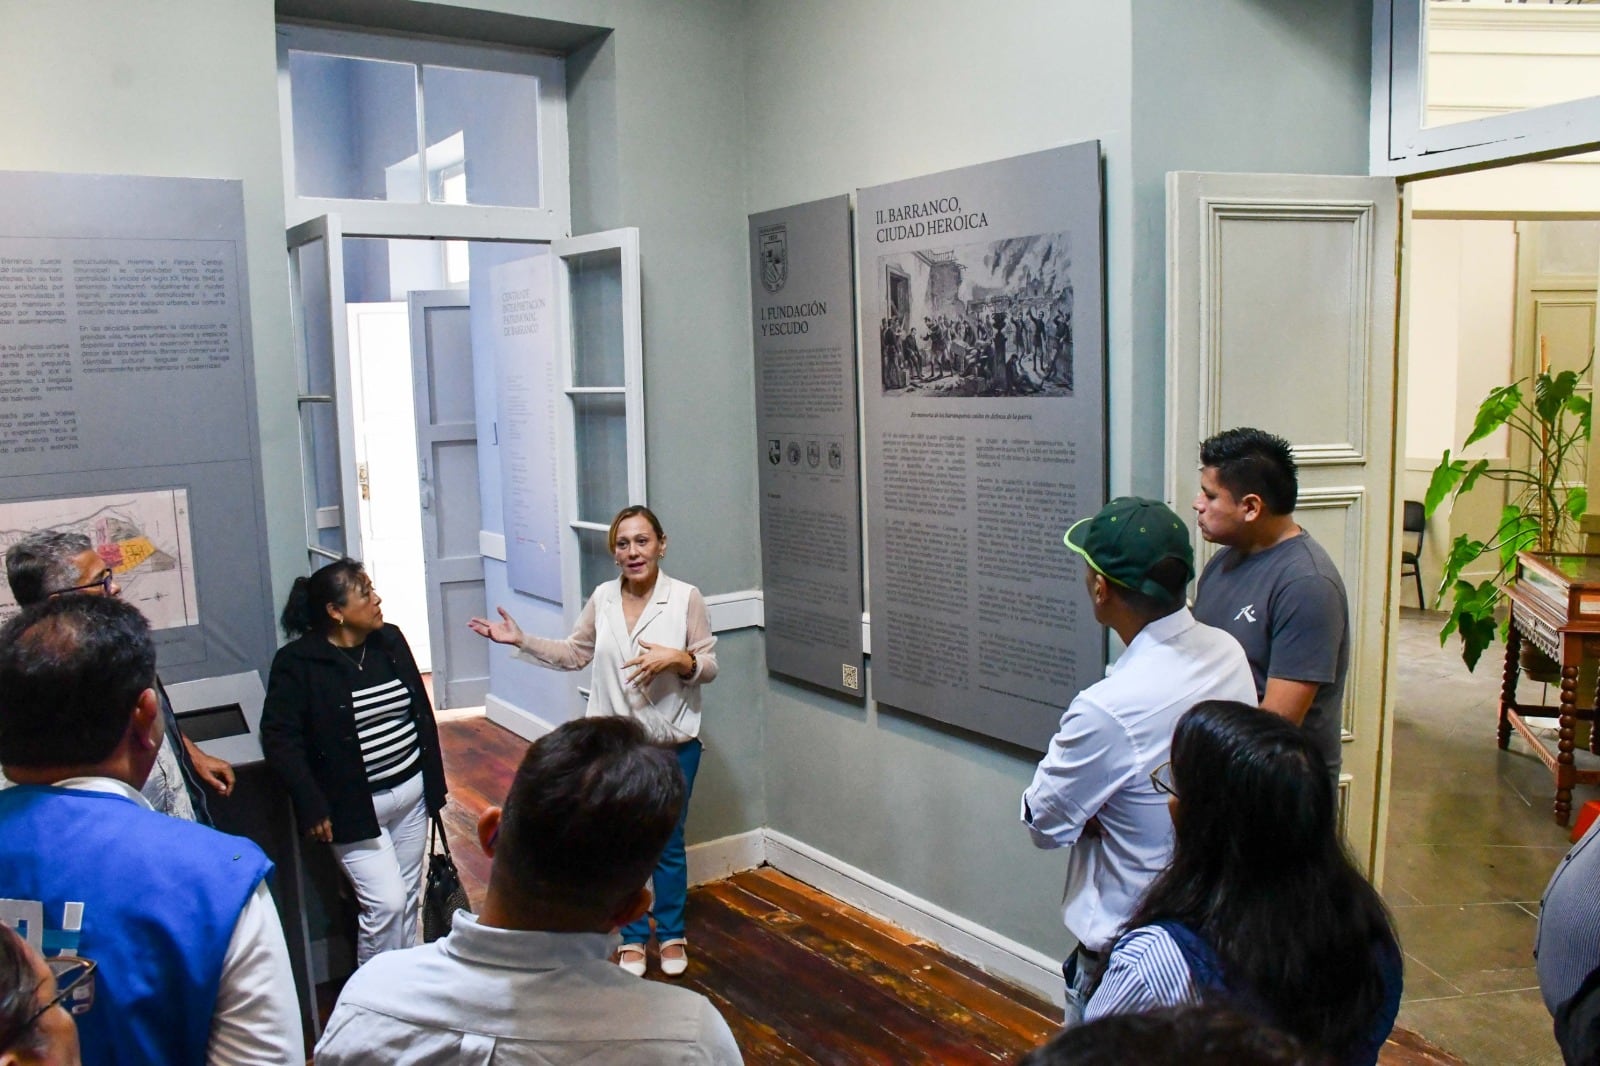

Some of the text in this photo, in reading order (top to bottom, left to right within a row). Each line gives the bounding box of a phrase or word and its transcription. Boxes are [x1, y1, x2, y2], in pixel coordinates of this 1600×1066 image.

[876, 196, 962, 226] II. BARRANCO,
[876, 212, 989, 244] CIUDAD HEROICA
[767, 300, 827, 320] FUNDACIÓN
[761, 321, 809, 336] Y ESCUDO
